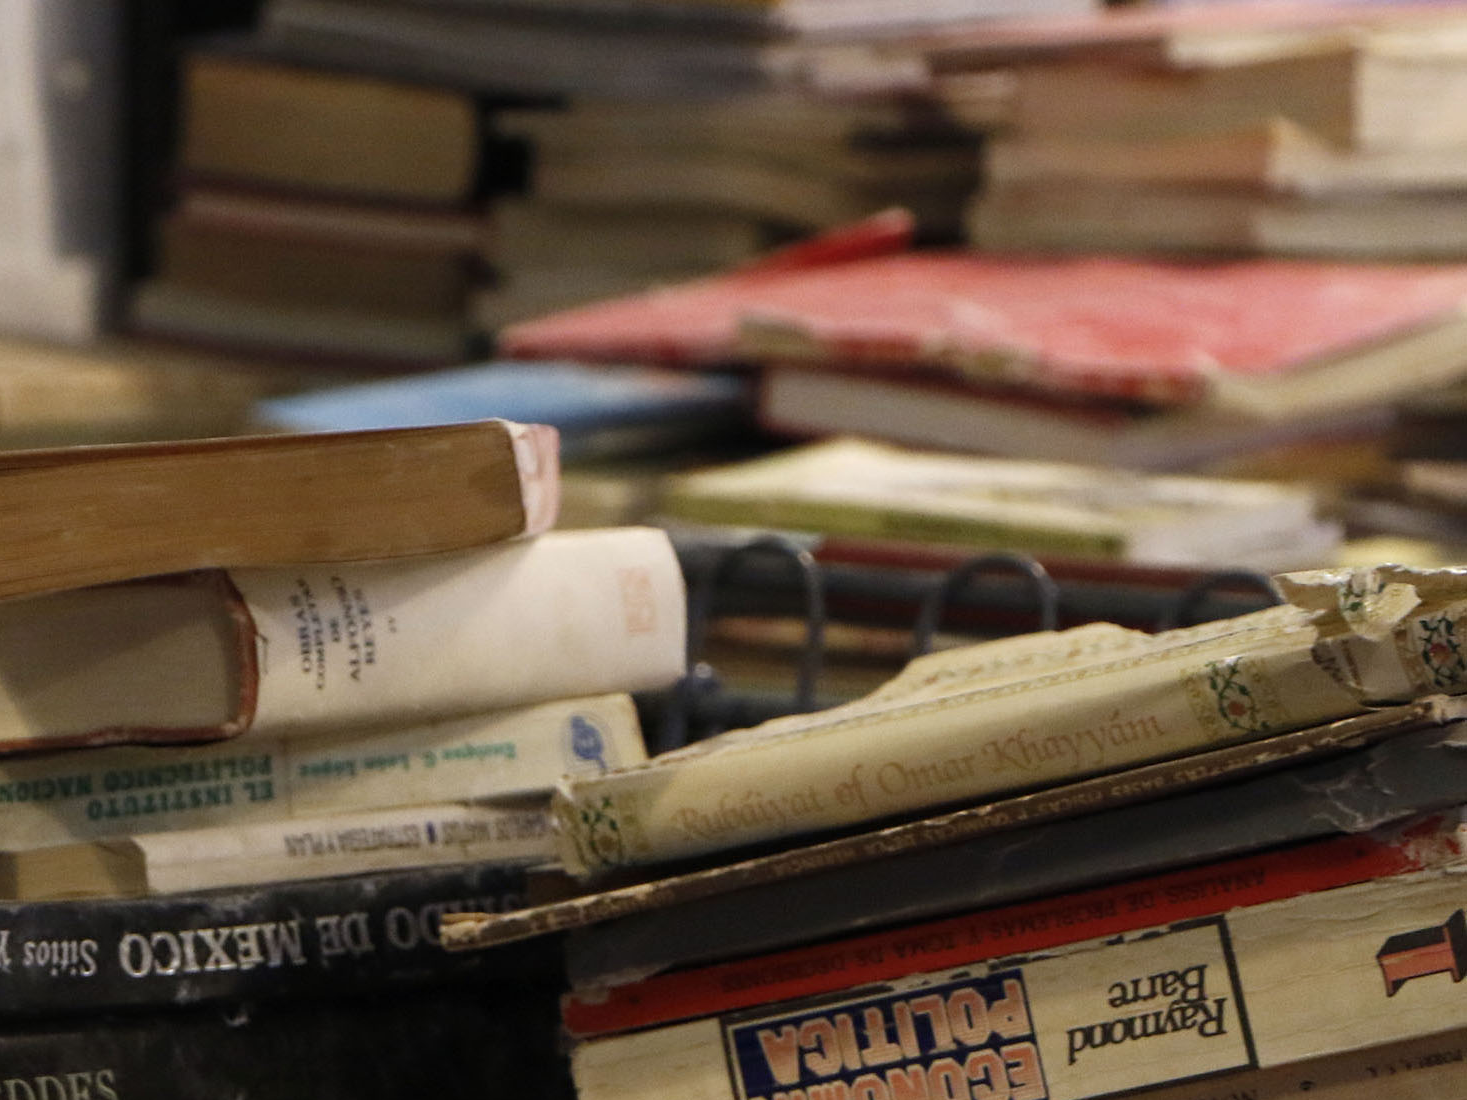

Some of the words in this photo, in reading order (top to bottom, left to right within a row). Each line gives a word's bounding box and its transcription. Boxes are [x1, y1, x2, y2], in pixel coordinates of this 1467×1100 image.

[88, 785, 234, 821] INSTITUTO
[244, 780, 277, 803] EL
[835, 764, 868, 810] of
[877, 753, 976, 796] Omar
[320, 909, 376, 958] DE
[22, 938, 98, 978] Sitios
[1106, 963, 1209, 1009] Barre
[757, 977, 1031, 1086] POLITICA
[1065, 997, 1228, 1066] Raymond
